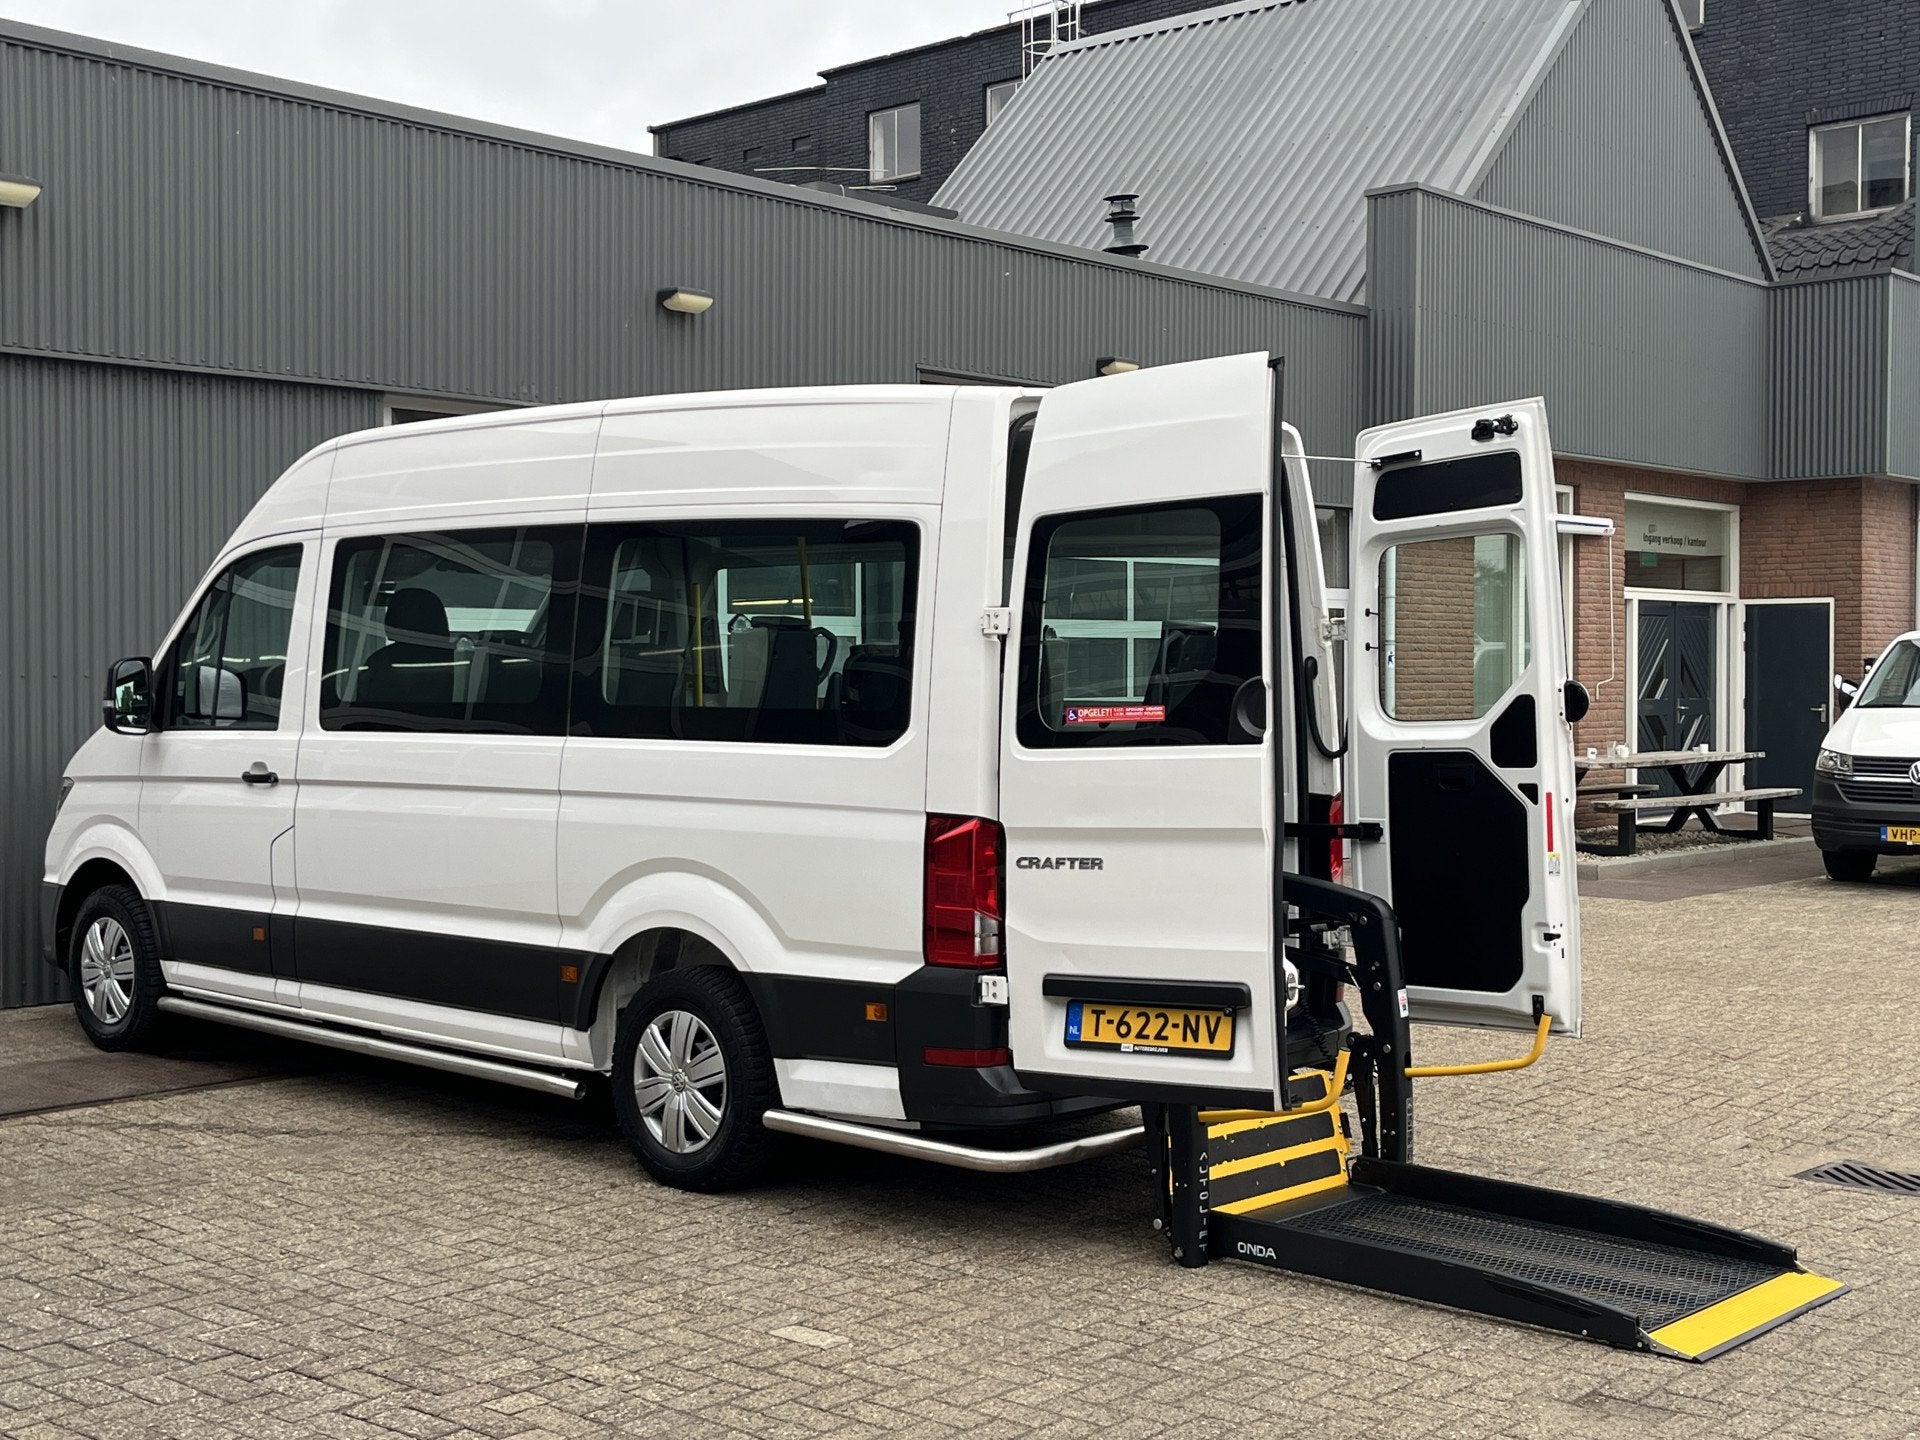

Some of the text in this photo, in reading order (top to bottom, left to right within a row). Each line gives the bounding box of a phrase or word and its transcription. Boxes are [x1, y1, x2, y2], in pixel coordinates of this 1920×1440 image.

[1643, 533, 1661, 545] Ingang
[1662, 535, 1683, 548] verkoop
[1016, 857, 1104, 870] CRAFTER
[1069, 1025, 1080, 1035] NL
[1091, 1009, 1222, 1045] T-622-NV
[1237, 1241, 1277, 1260] ONDA
